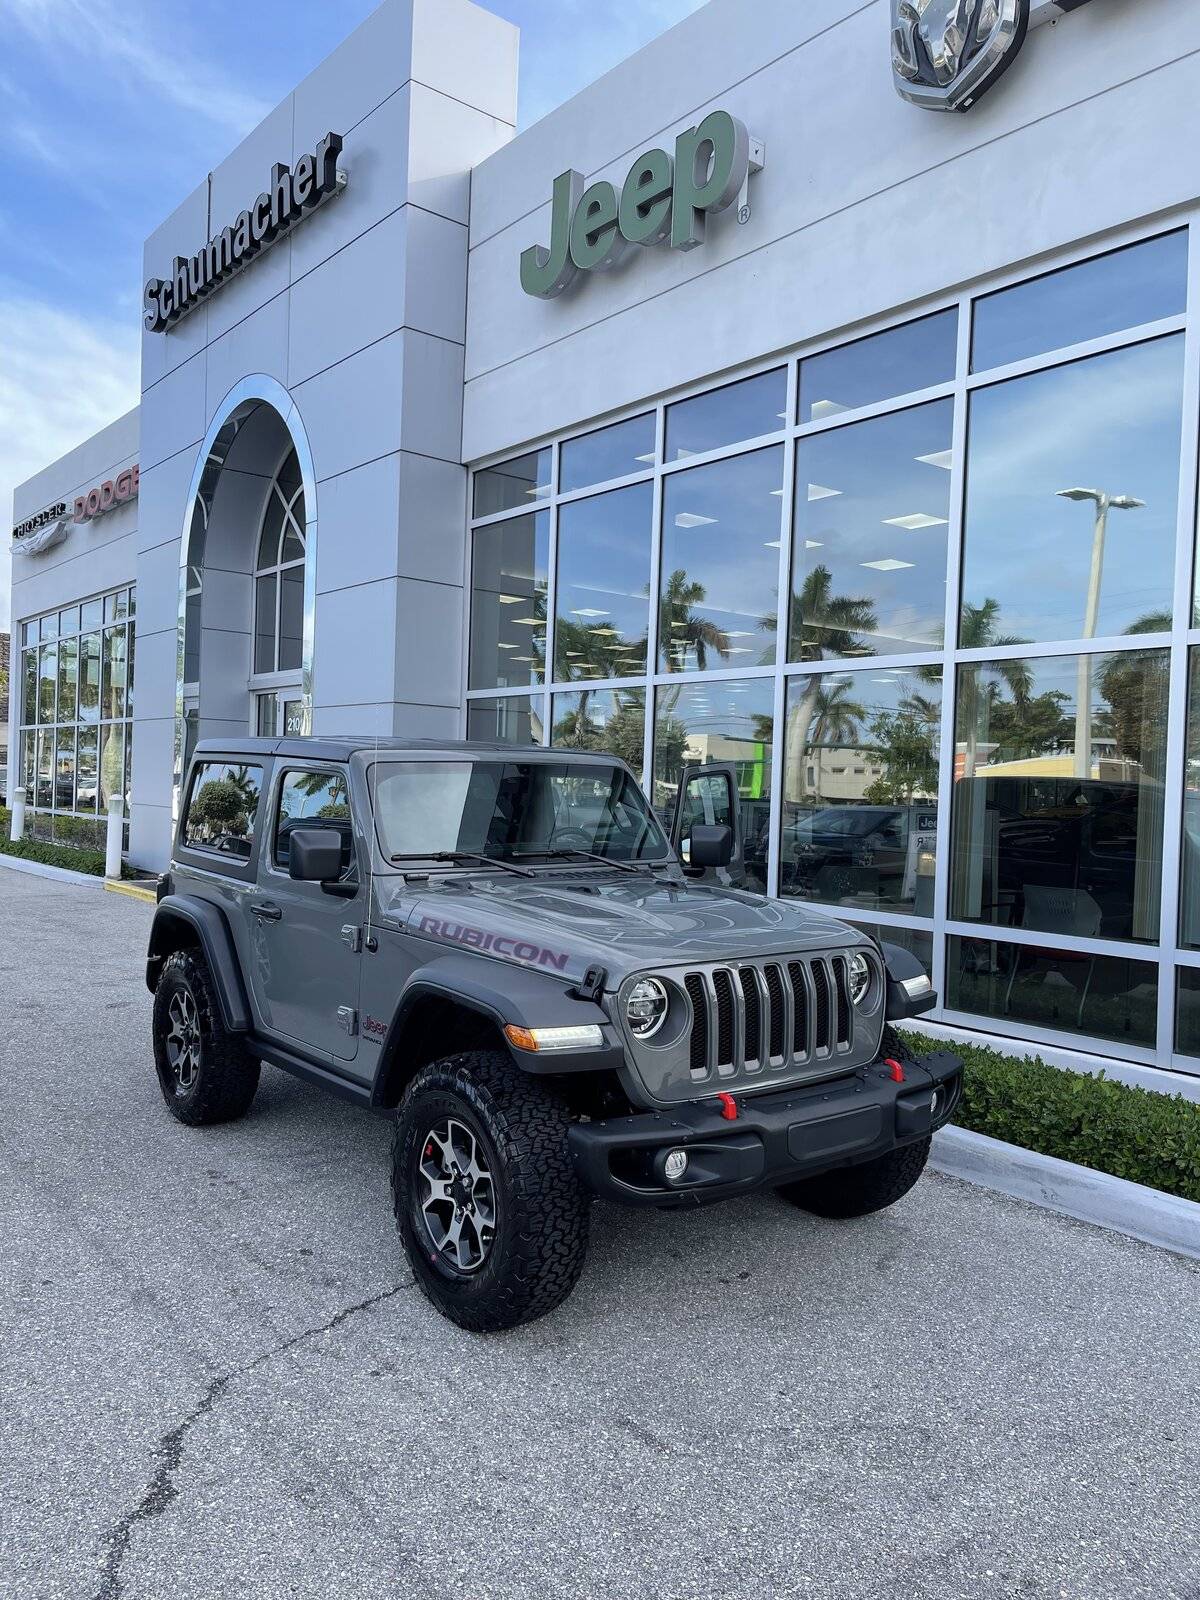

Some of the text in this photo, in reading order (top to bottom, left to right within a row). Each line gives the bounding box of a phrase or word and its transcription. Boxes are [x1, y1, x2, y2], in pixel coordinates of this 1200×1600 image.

[144, 132, 342, 333] Schumacher
[520, 110, 749, 300] Jeep
[920, 817, 937, 828] Je
[419, 916, 569, 970] RUBICON
